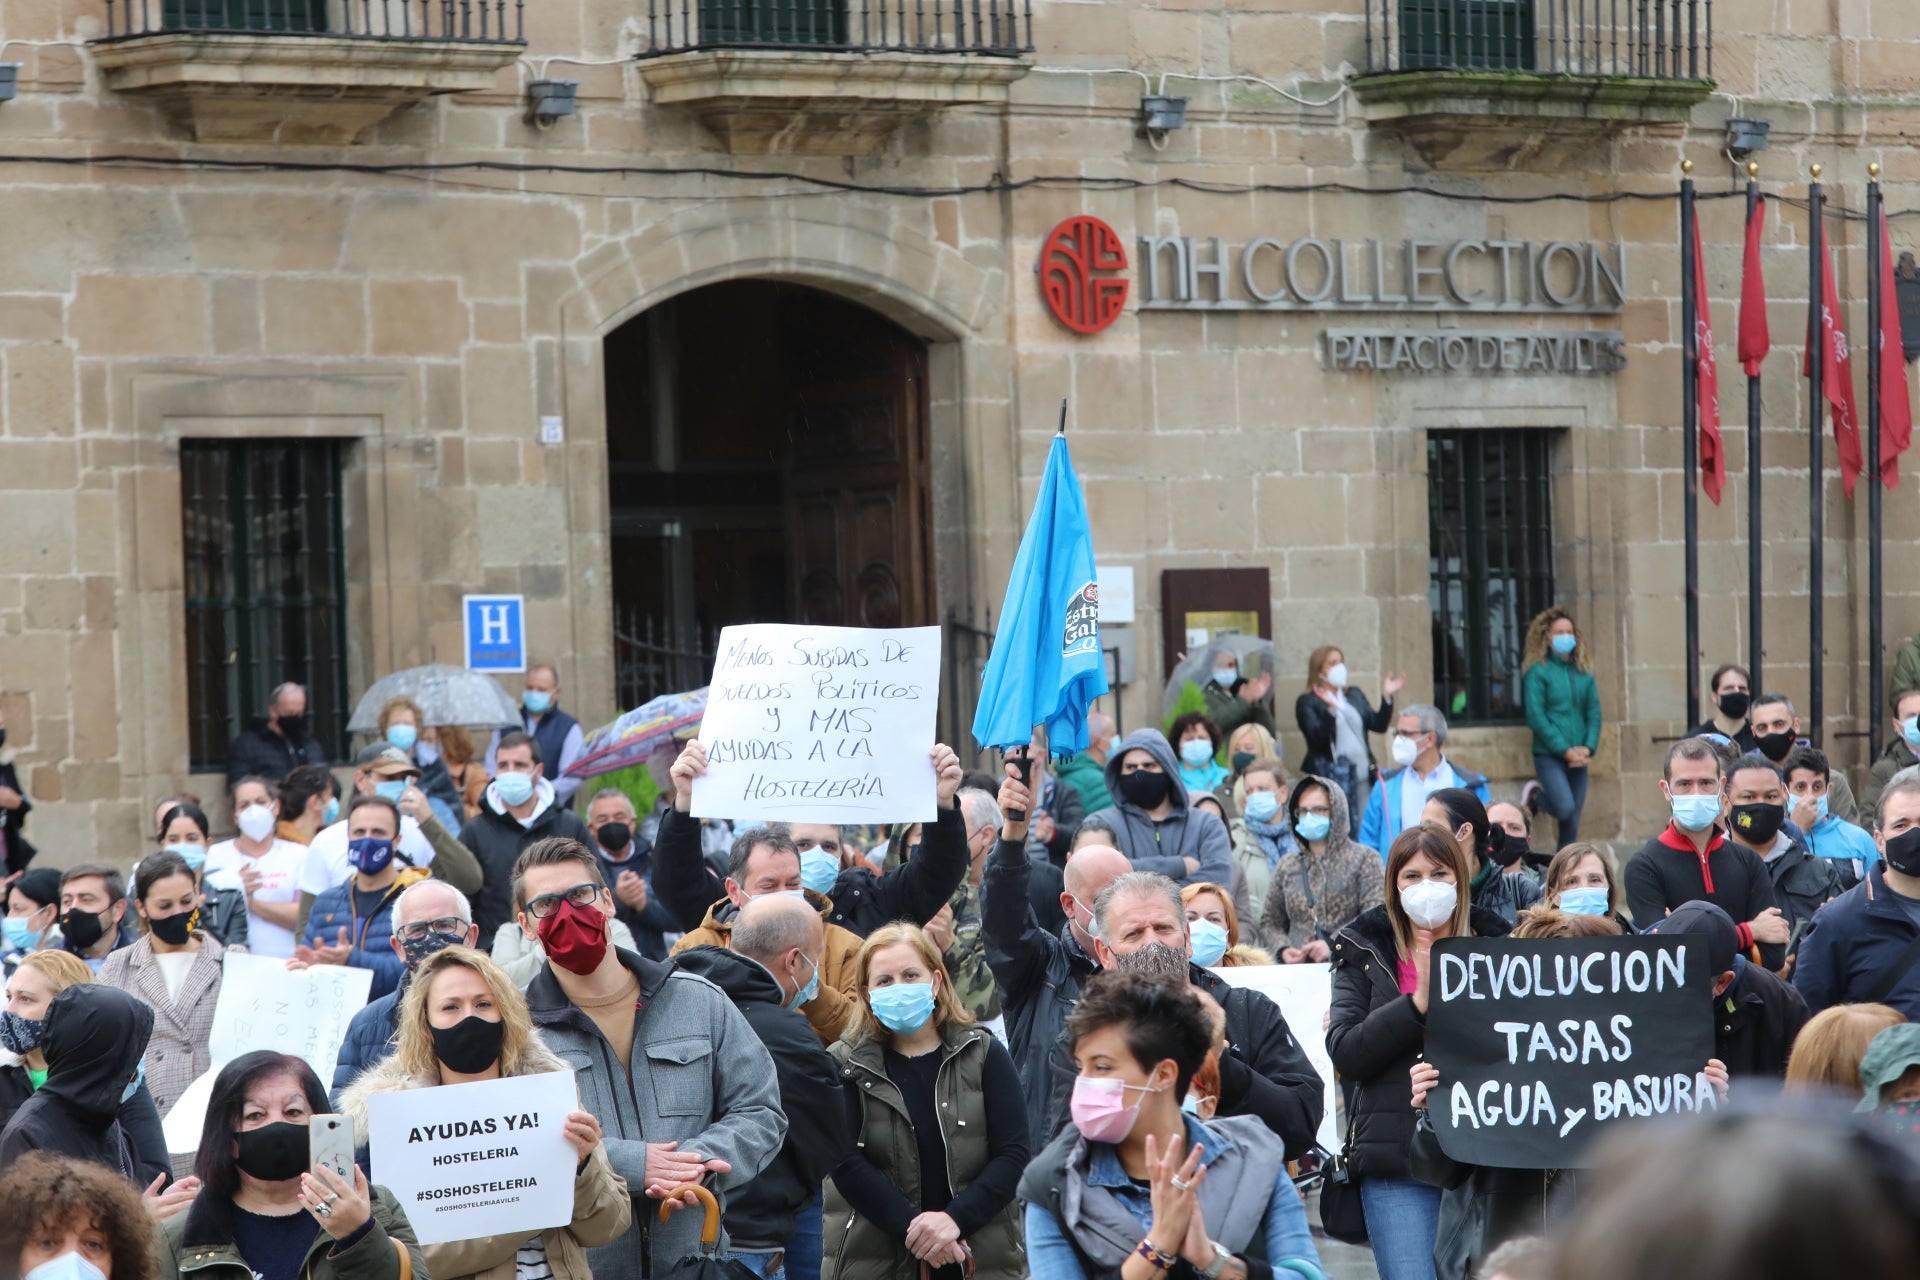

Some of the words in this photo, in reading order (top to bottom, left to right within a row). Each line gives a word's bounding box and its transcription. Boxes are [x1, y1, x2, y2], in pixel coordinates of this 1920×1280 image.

[1242, 237, 1628, 306] COLLECTION
[1331, 335, 1468, 370] PALACIO
[1477, 336, 1517, 370] DE
[478, 605, 512, 645] H
[722, 637, 774, 670] MENOS
[880, 638, 915, 663] DE
[718, 679, 792, 701] SUELDOS
[809, 707, 876, 733] MAS
[707, 739, 793, 763] AYUDAS
[808, 740, 826, 762] A
[837, 738, 873, 759] LA
[1440, 945, 1686, 1002] DEVOLUCION
[1494, 1014, 1633, 1064] TASAS
[1451, 1080, 1557, 1129] AGUA
[1592, 1071, 1717, 1121] BASURA
[408, 1117, 497, 1144] AYUDAS
[503, 1112, 540, 1132] YA!
[432, 1146, 519, 1167] HOSTELERIA
[416, 1176, 538, 1202] #SOSHOSTELERIA
[435, 1196, 520, 1212] #SOSHOSTELERIAAVILES
